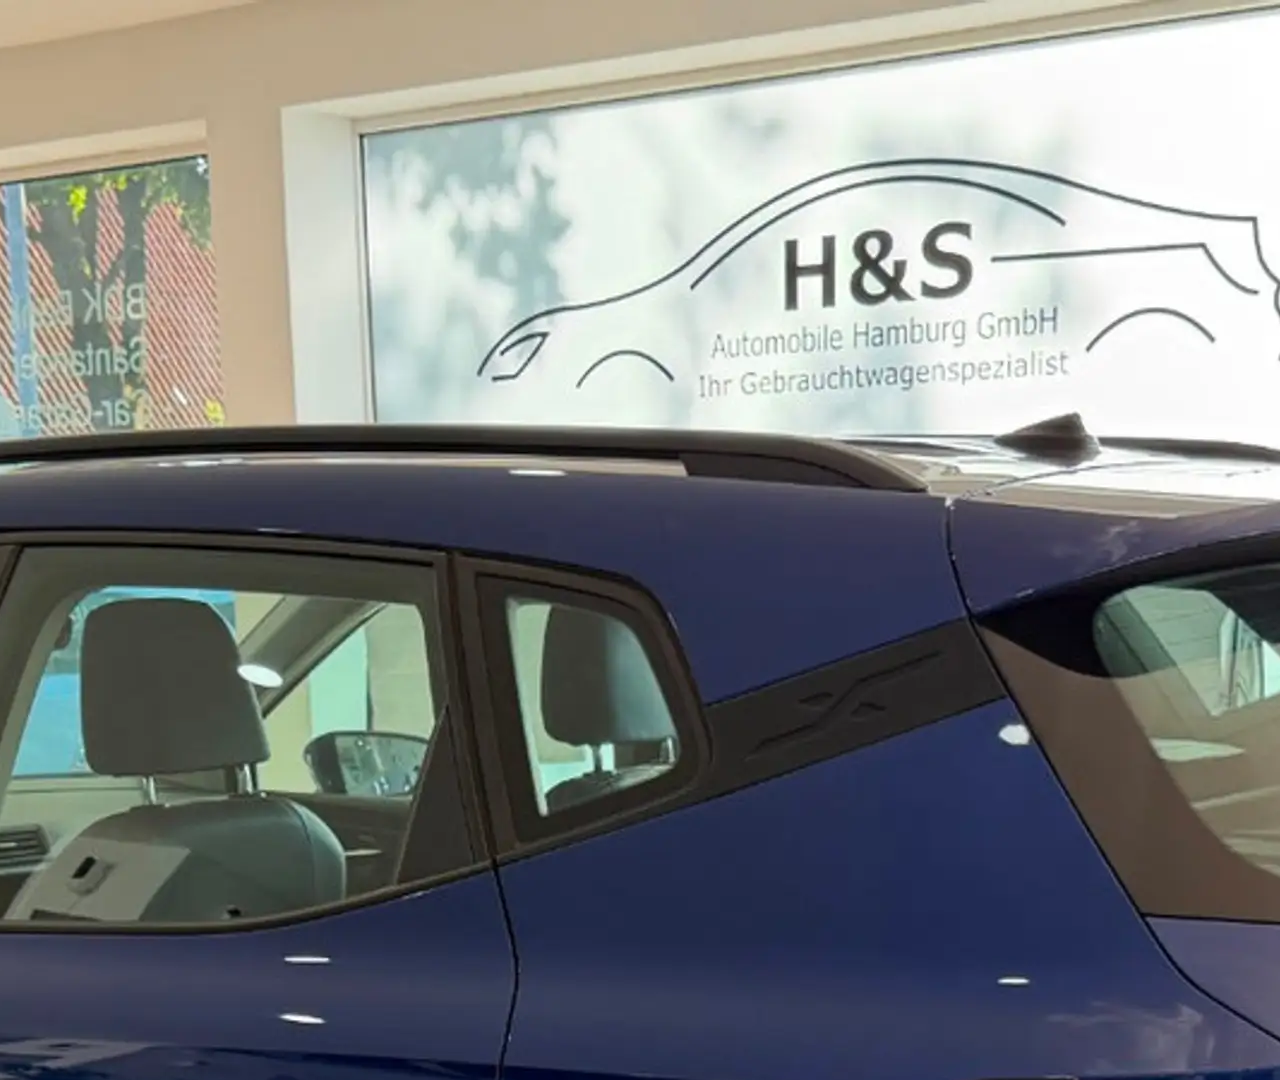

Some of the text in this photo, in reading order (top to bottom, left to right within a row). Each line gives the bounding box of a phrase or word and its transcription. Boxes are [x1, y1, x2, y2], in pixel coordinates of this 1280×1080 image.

[783, 221, 974, 312] H&S
[709, 306, 1060, 359] Automobile Hamburg GmbH
[697, 352, 1071, 399] Ihr Gebrauchtwagenspezialist
